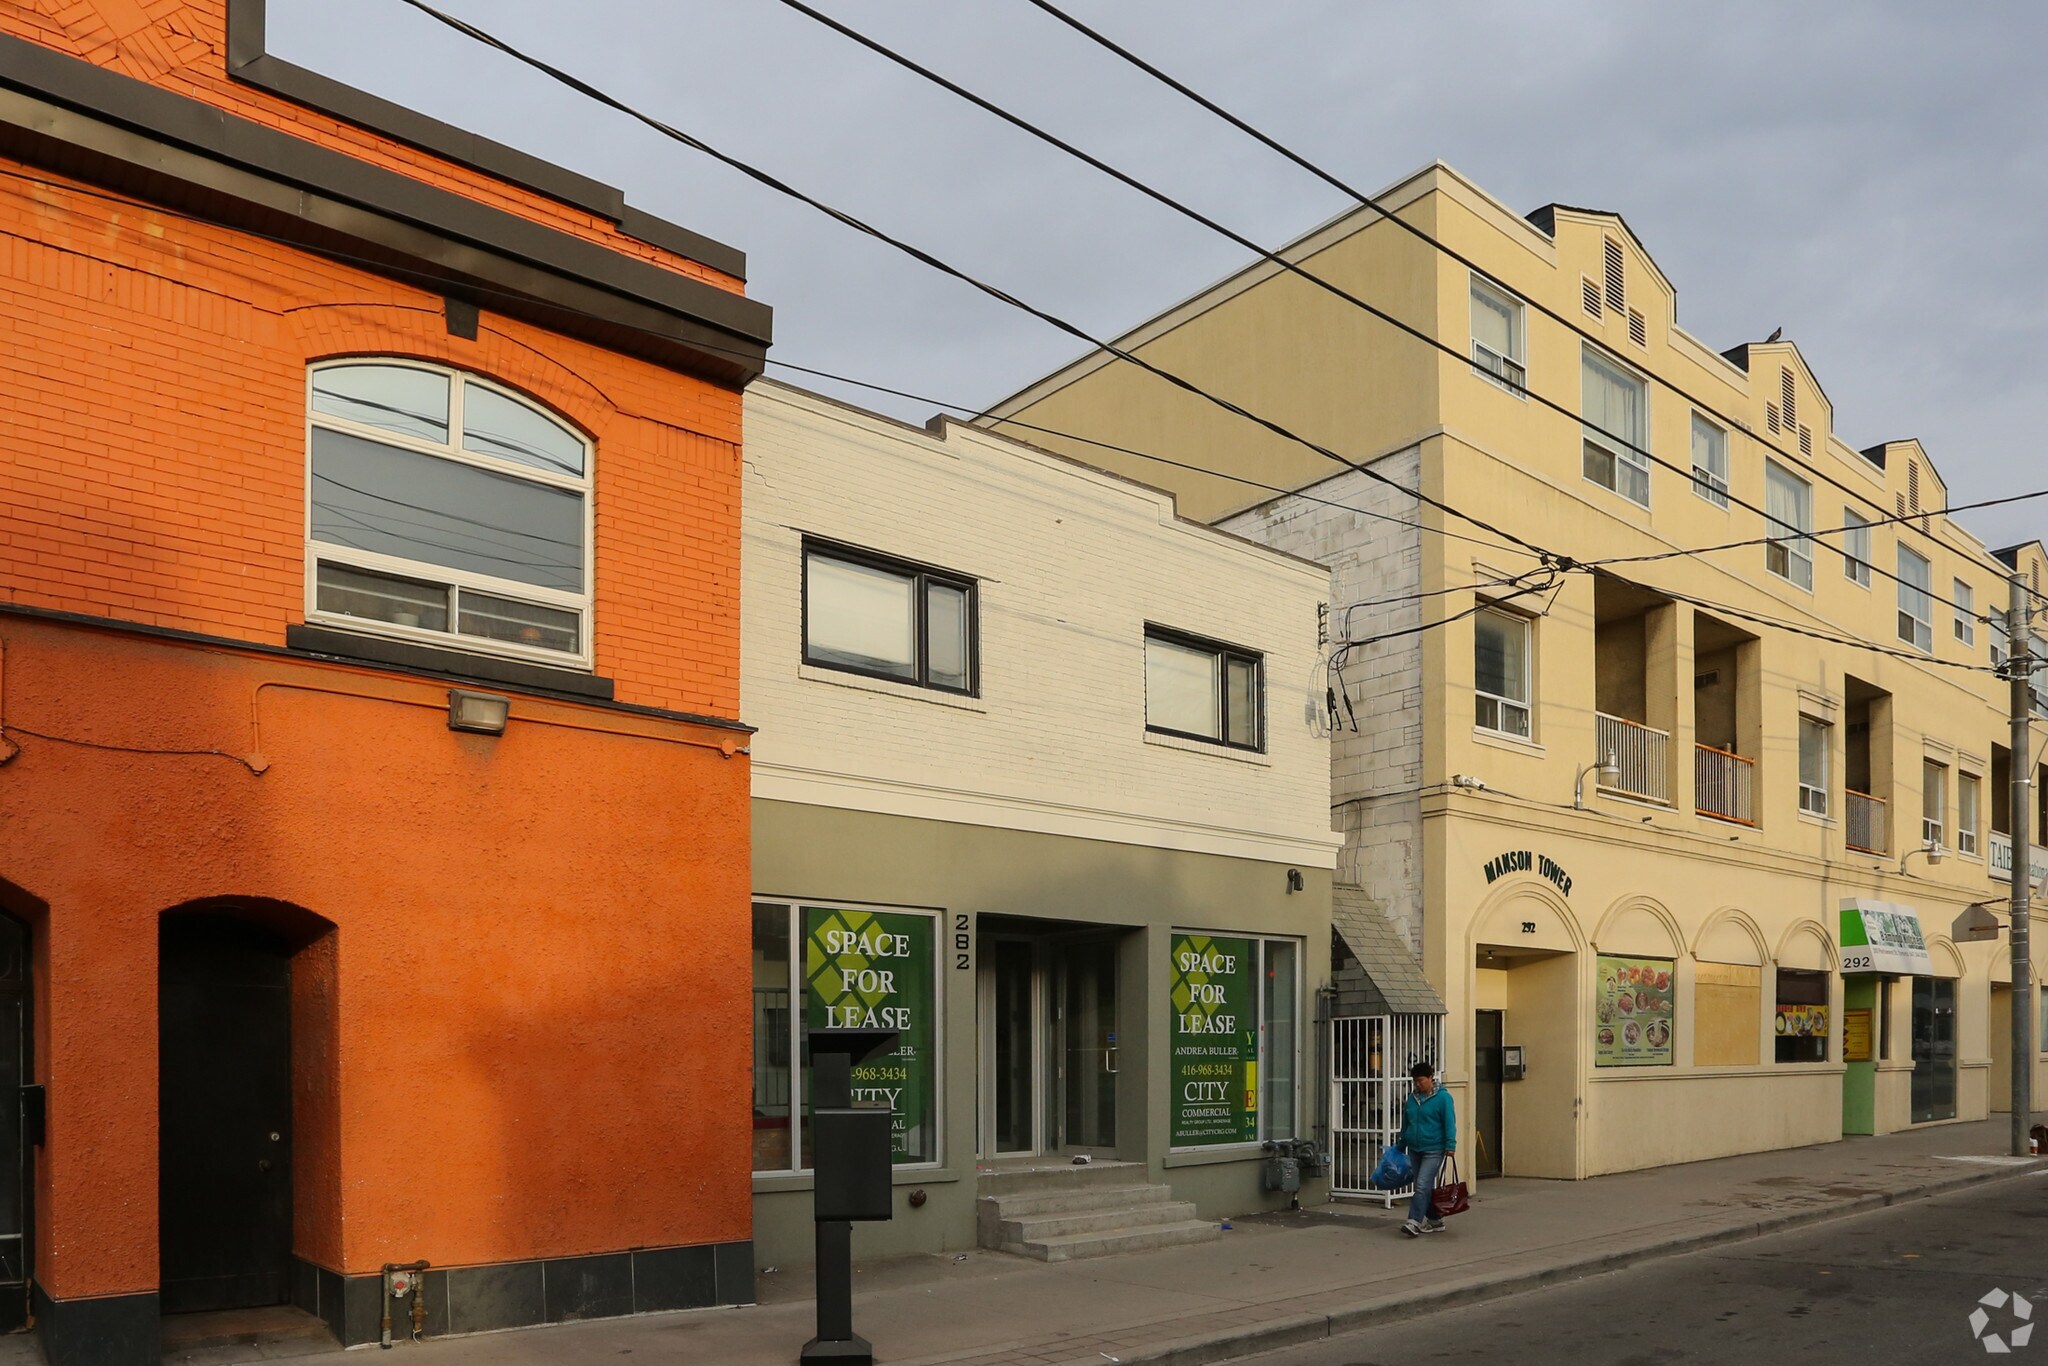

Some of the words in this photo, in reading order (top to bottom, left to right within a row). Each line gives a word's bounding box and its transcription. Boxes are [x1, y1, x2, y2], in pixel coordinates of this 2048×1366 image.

[1483, 851, 1532, 884] MANSON
[1538, 854, 1572, 897] TOWER
[1521, 922, 1536, 933] 292
[826, 930, 911, 957] SPACE
[1180, 952, 1236, 974] SPACE
[1843, 956, 1870, 968] 292
[841, 968, 897, 993] FOR
[1189, 984, 1227, 1004] FOR
[825, 1006, 911, 1030] LEASE
[1179, 1014, 1236, 1034] LEASE
[1175, 1047, 1208, 1055] ANDREA
[1181, 1065, 1233, 1076] 416-968-3434
[1184, 1081, 1230, 1102] CITY
[1182, 1108, 1231, 1118] COMMERCIAL
